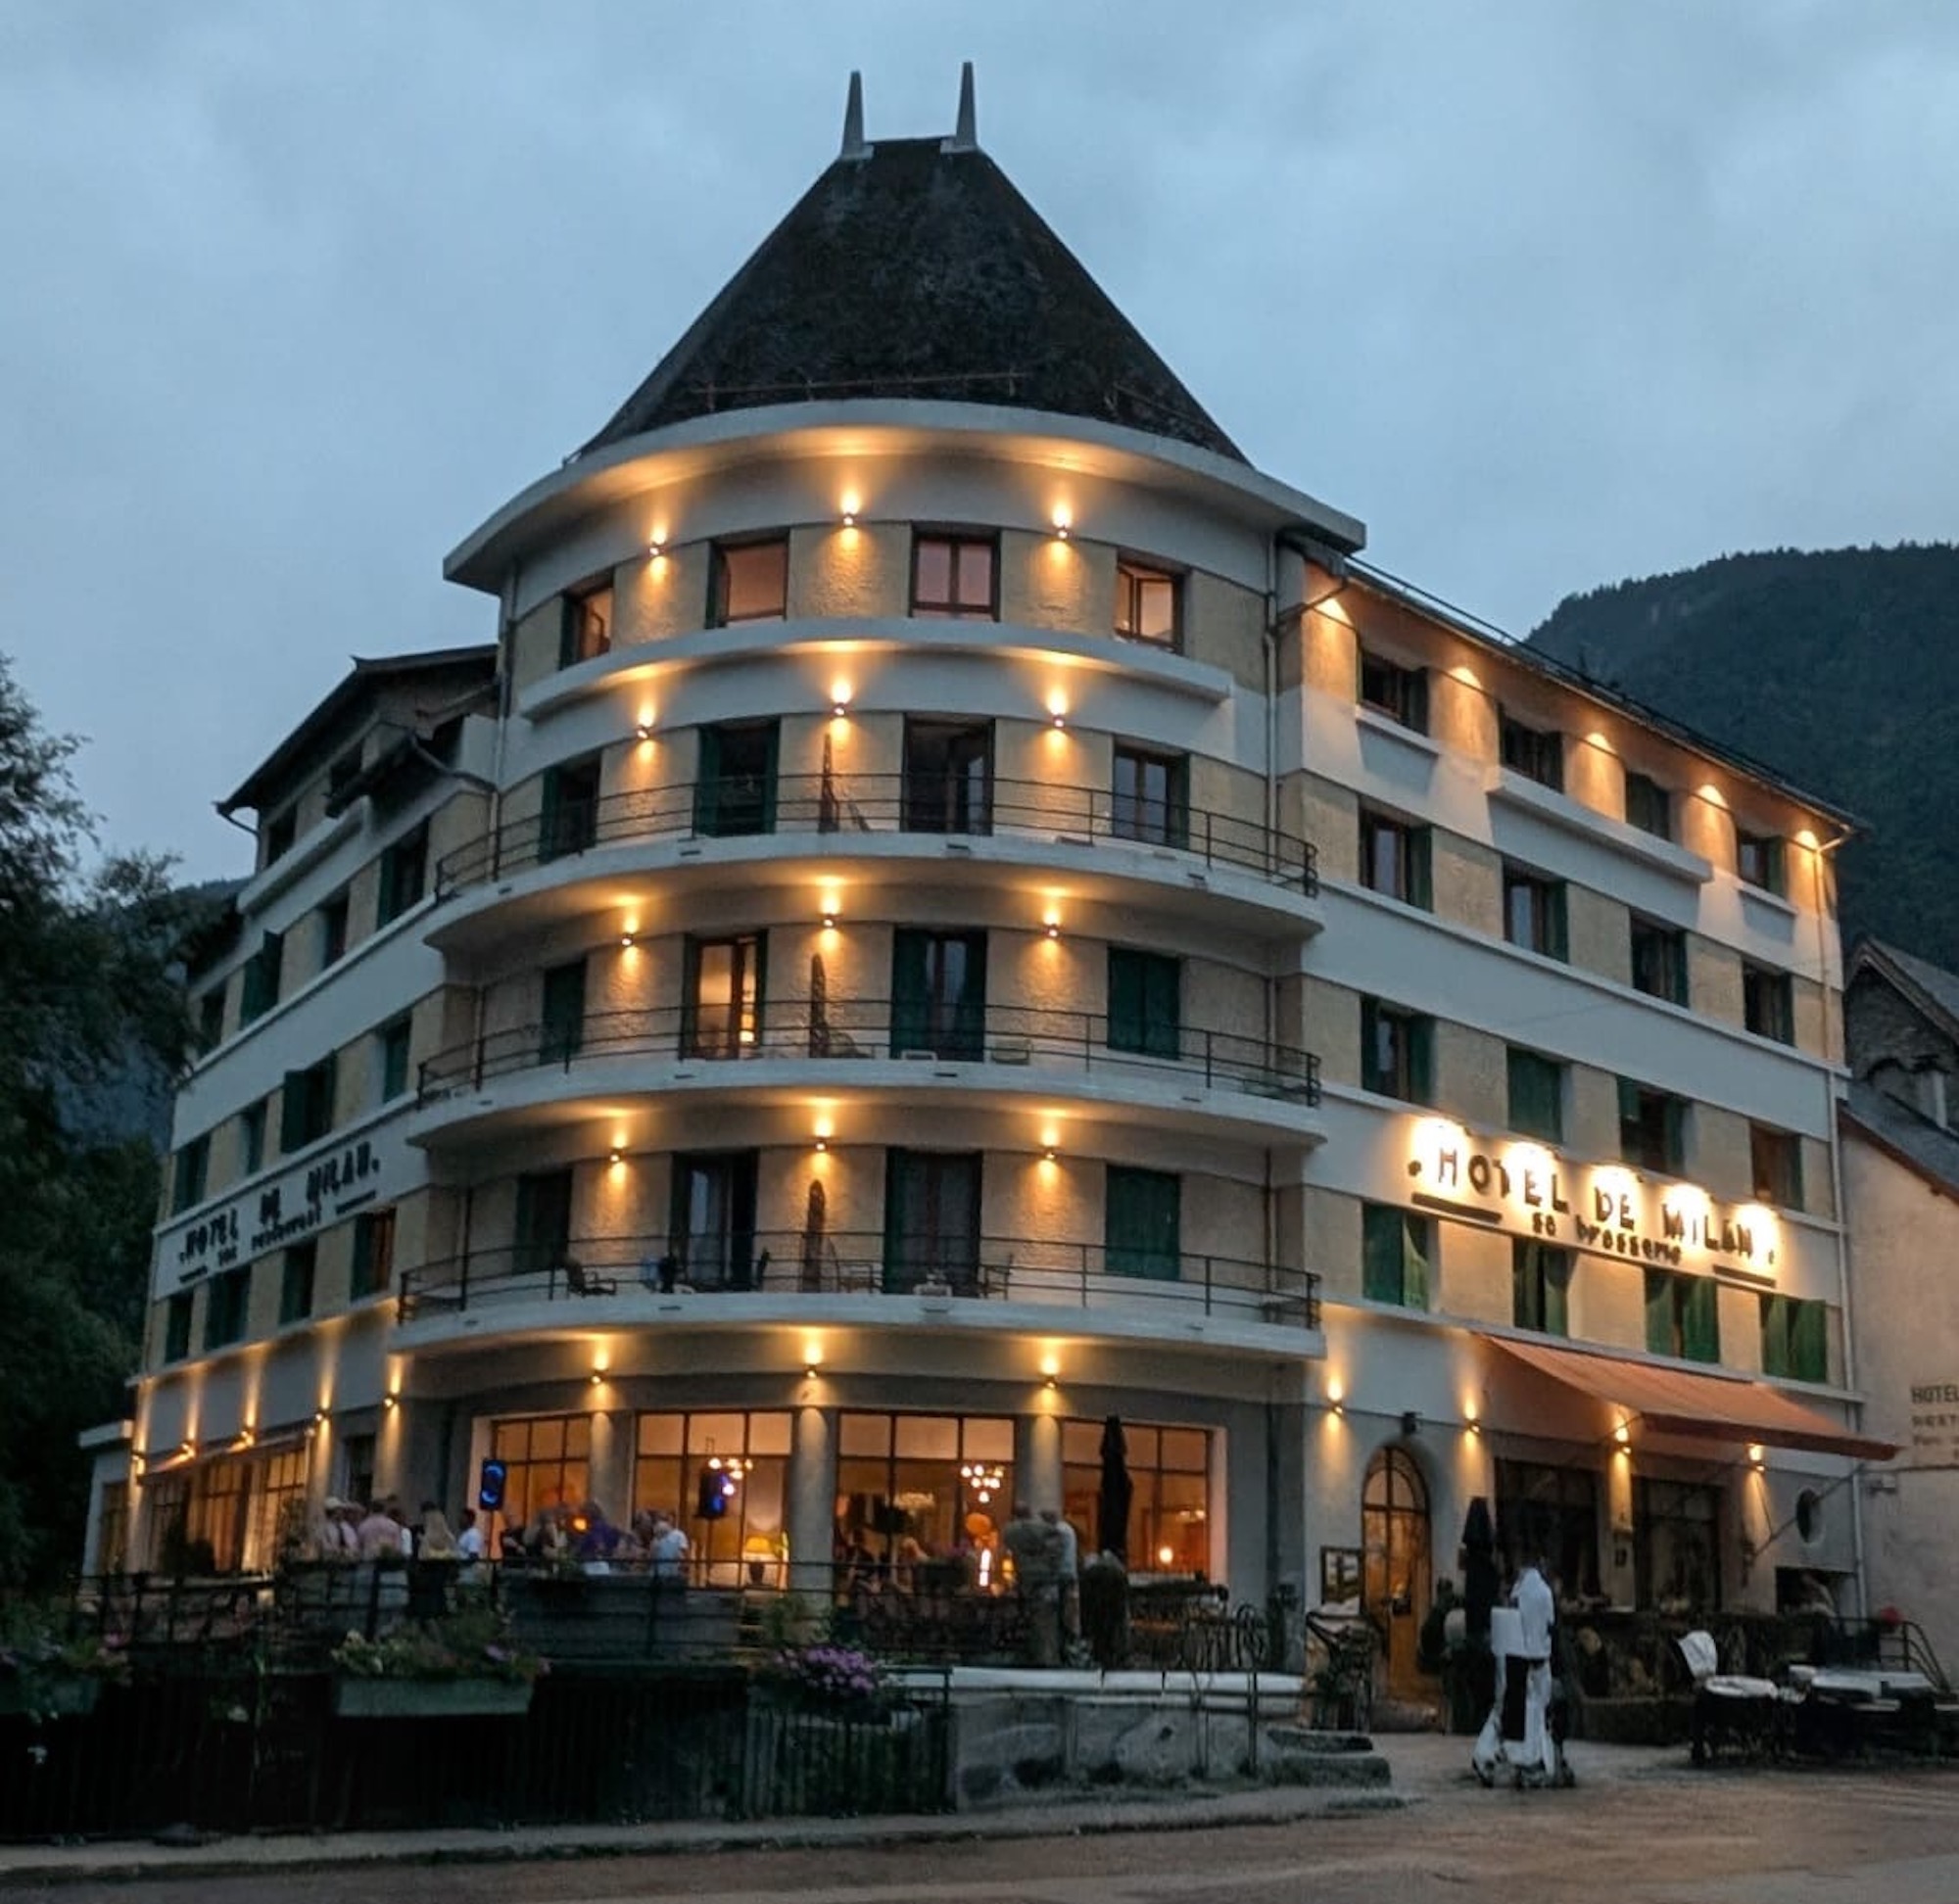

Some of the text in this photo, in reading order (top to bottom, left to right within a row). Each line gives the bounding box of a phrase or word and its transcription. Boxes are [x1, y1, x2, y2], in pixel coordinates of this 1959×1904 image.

[1438, 1148, 1753, 1260] HOTEL DE MILAN
